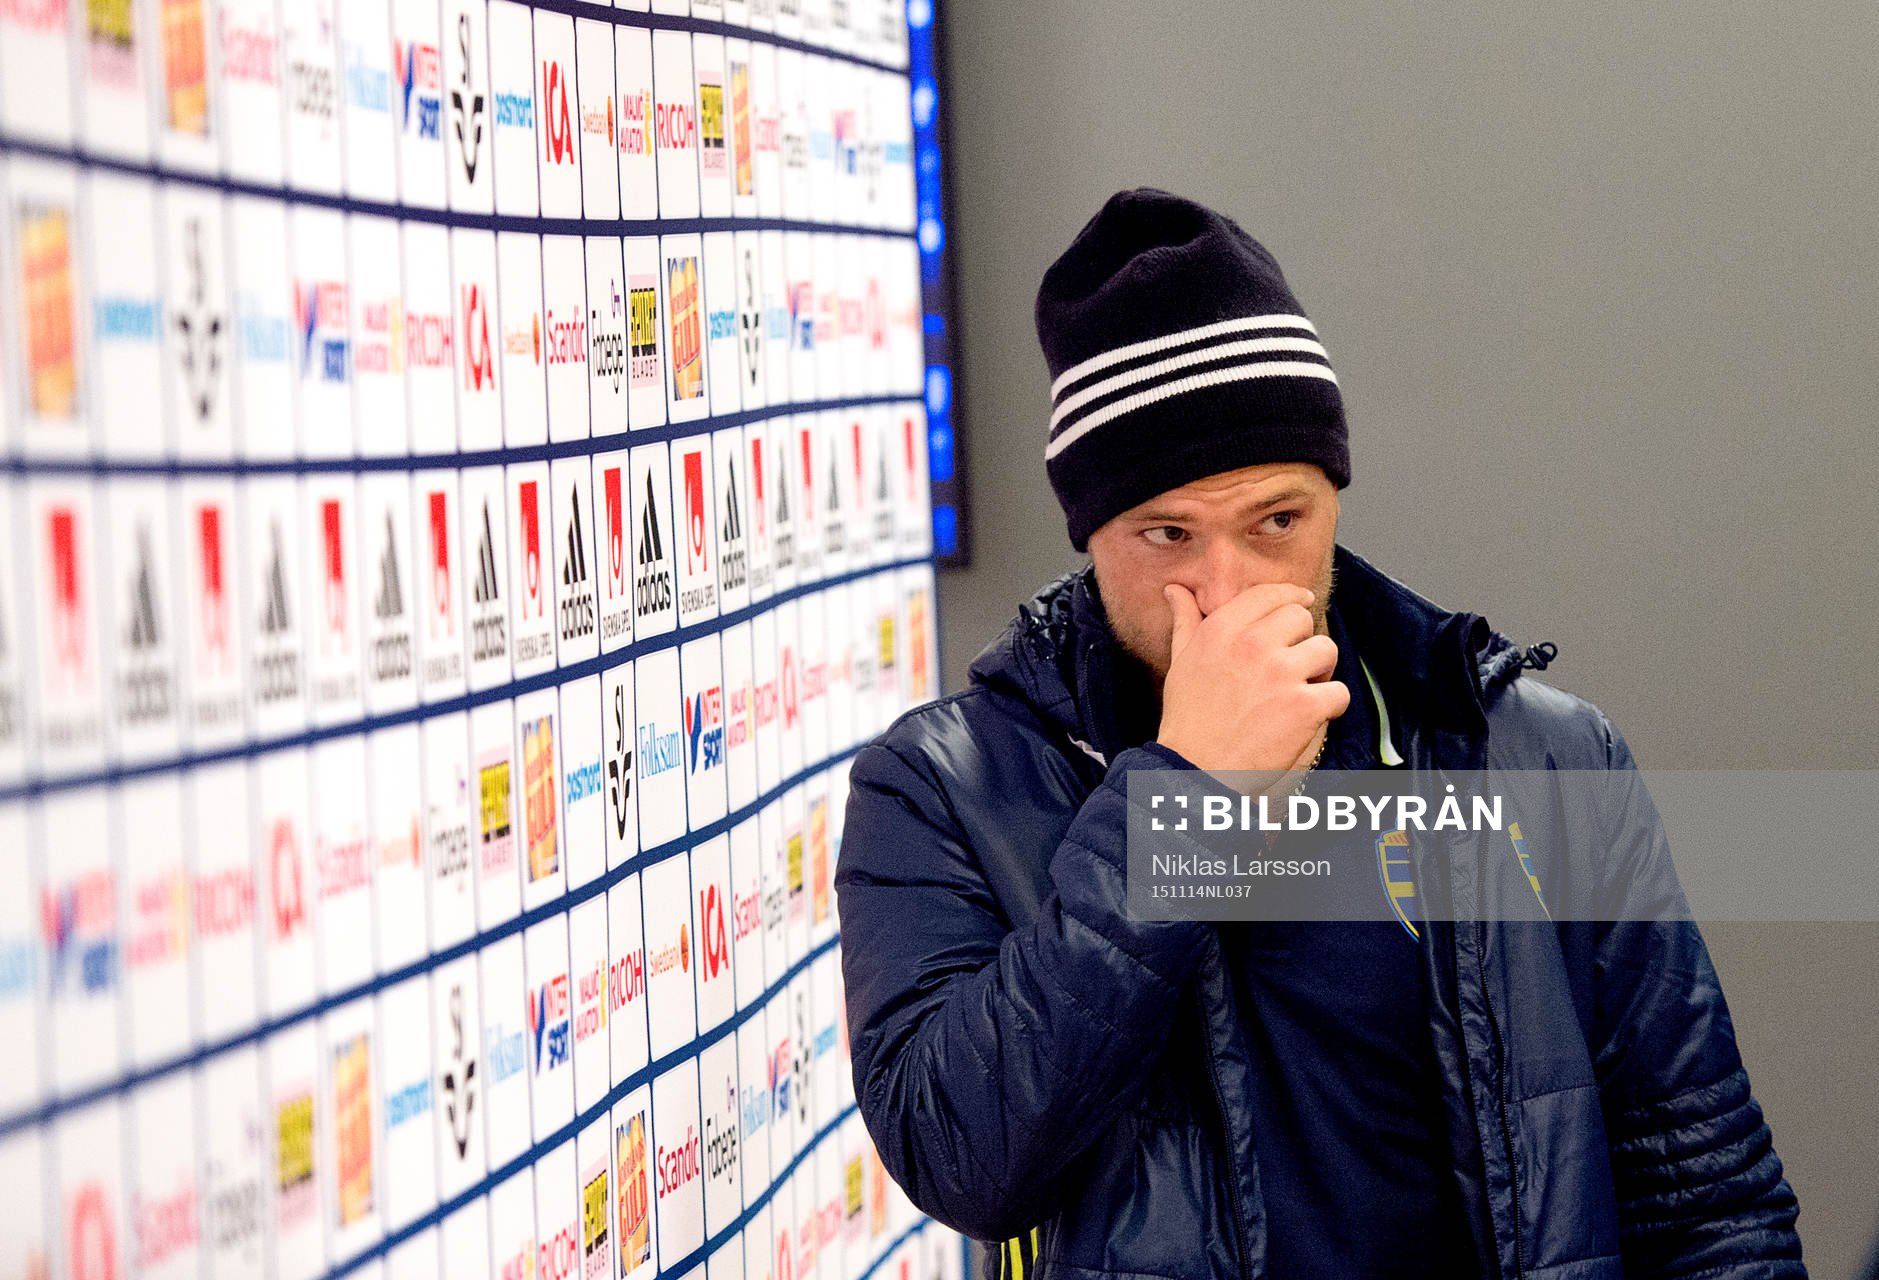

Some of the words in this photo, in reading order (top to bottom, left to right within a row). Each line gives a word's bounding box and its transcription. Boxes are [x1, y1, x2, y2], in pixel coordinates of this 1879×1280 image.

[543, 60, 575, 165] ICA
[657, 103, 696, 149] RICOH
[548, 305, 585, 364] Scandic
[592, 309, 623, 394] Fabege
[561, 580, 594, 640] adidas
[636, 560, 671, 617] adidas
[639, 722, 680, 779] Folksam
[700, 881, 729, 983] ICA
[610, 948, 644, 1014] RICOH
[658, 1124, 700, 1199] Scandic
[619, 1168, 648, 1247] GULD
